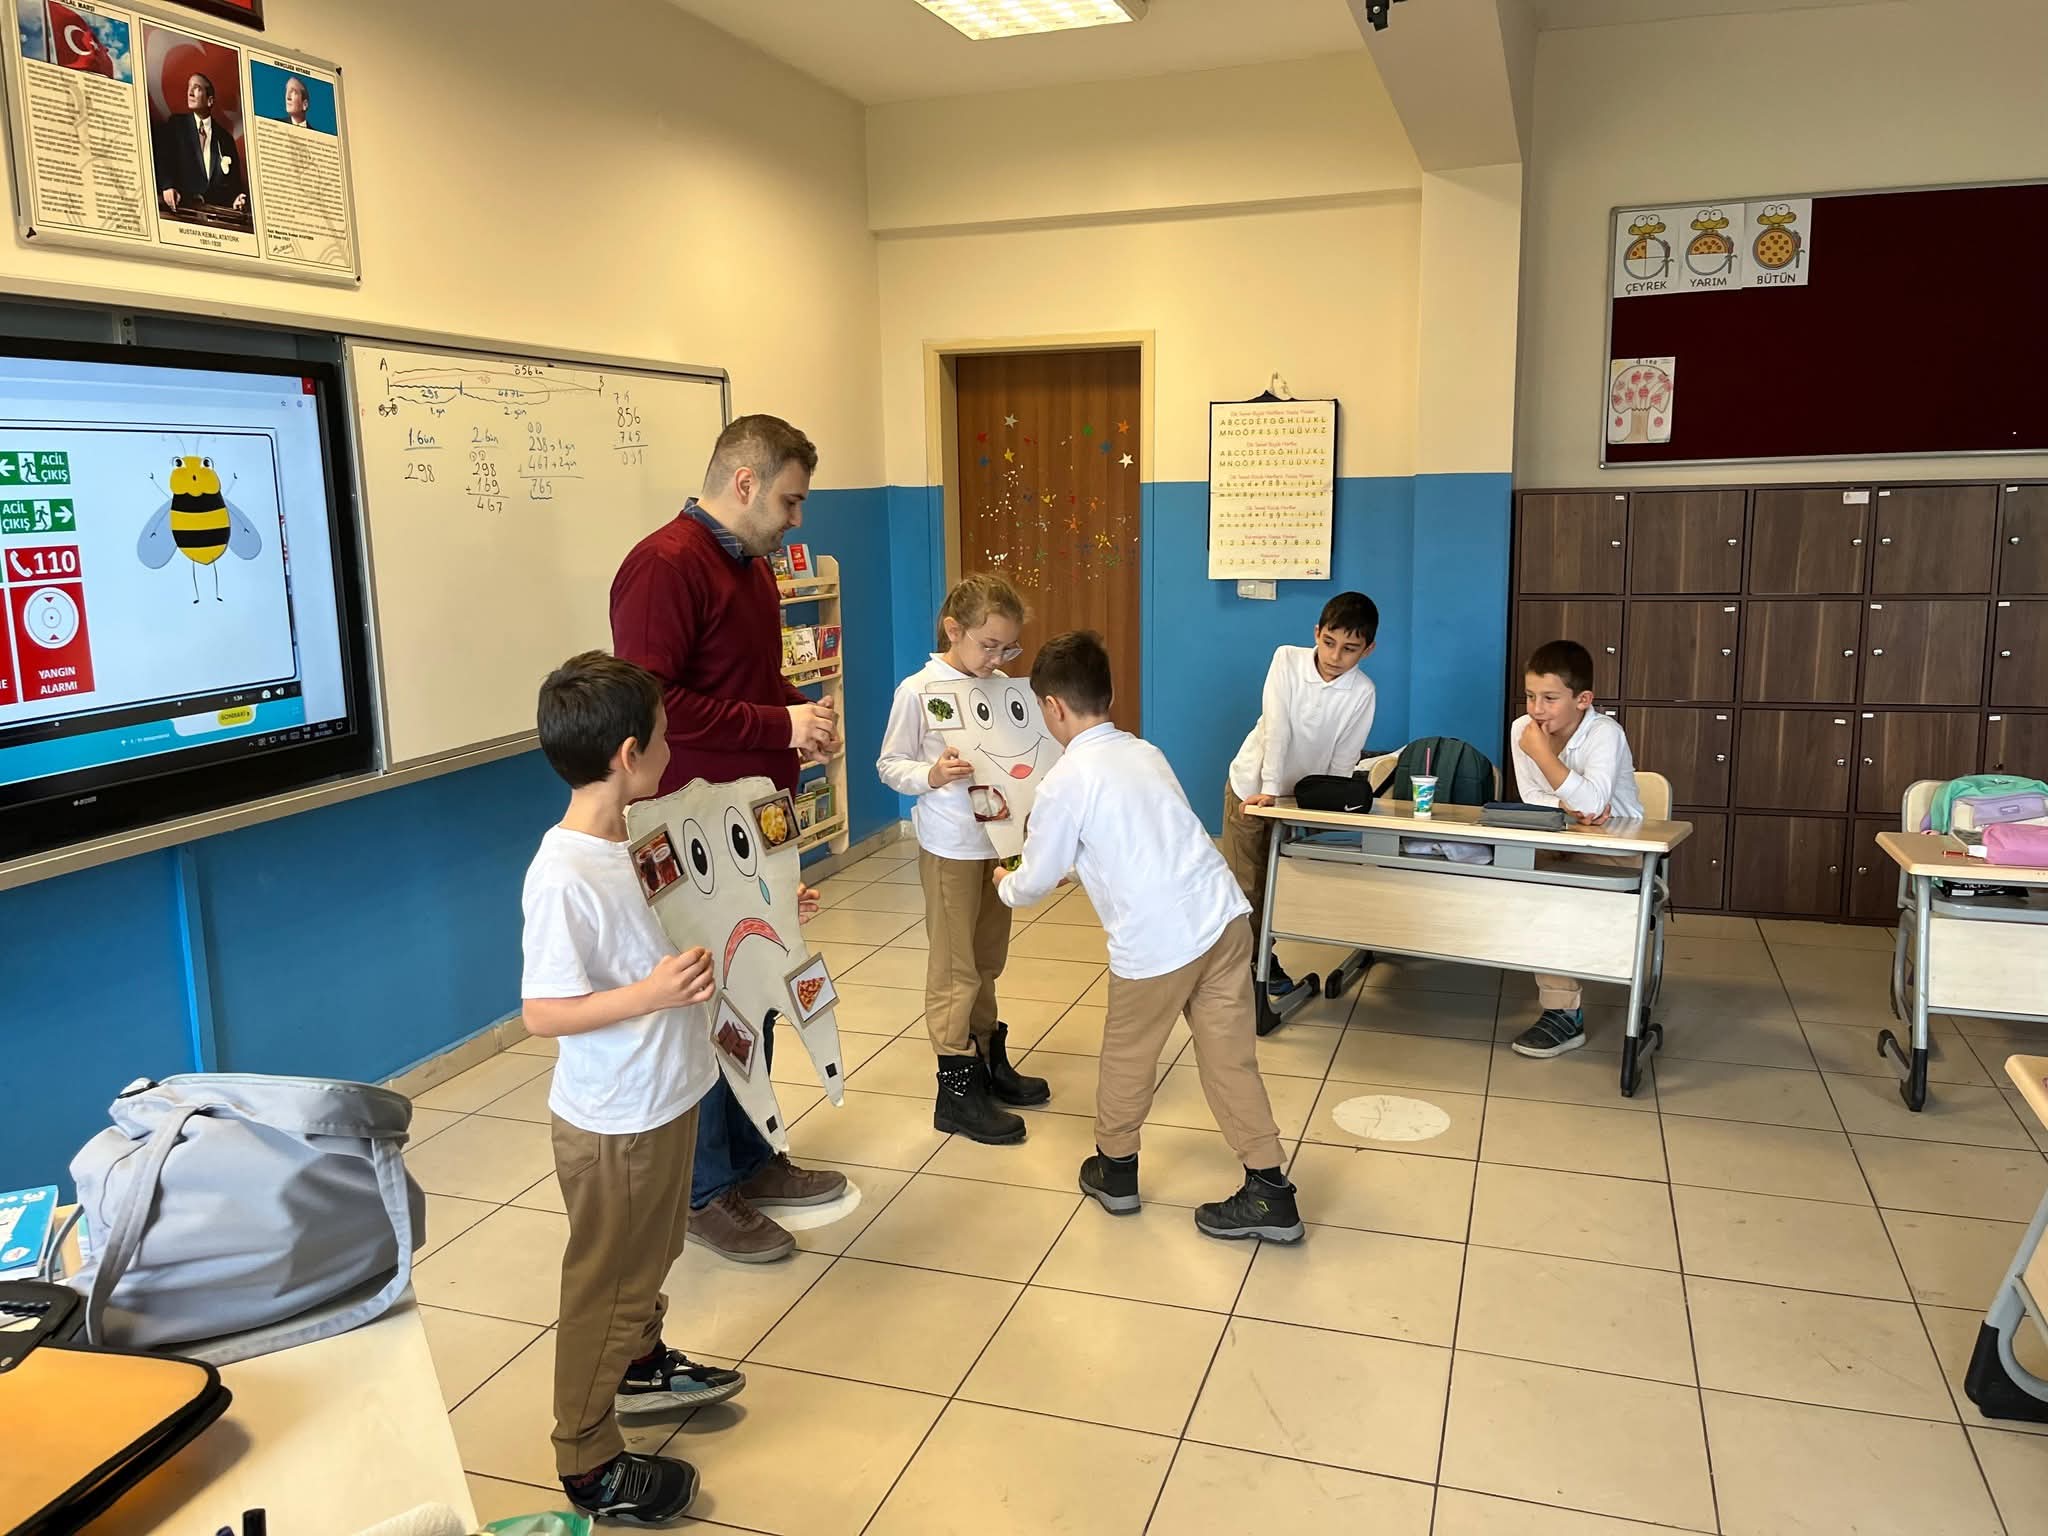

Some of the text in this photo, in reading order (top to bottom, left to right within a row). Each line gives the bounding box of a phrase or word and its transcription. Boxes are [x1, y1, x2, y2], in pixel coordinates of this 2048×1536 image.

[1690, 277, 1727, 288] YARIM
[1757, 273, 1796, 284] BÜTÜN
[1625, 280, 1667, 295] ÇEYREK
[380, 358, 388, 370] A
[618, 406, 640, 428] 856
[41, 452, 64, 465] ACİL
[41, 470, 68, 482] ÇIKIŞ
[404, 462, 435, 483] 298
[472, 462, 497, 477] 298
[3, 501, 27, 514] ACİL
[477, 496, 502, 513] 467
[3, 518, 30, 532] ÇIKIŞ
[34, 551, 76, 574] 110
[38, 666, 76, 679] YANGIN
[40, 681, 78, 694] ALARMI
